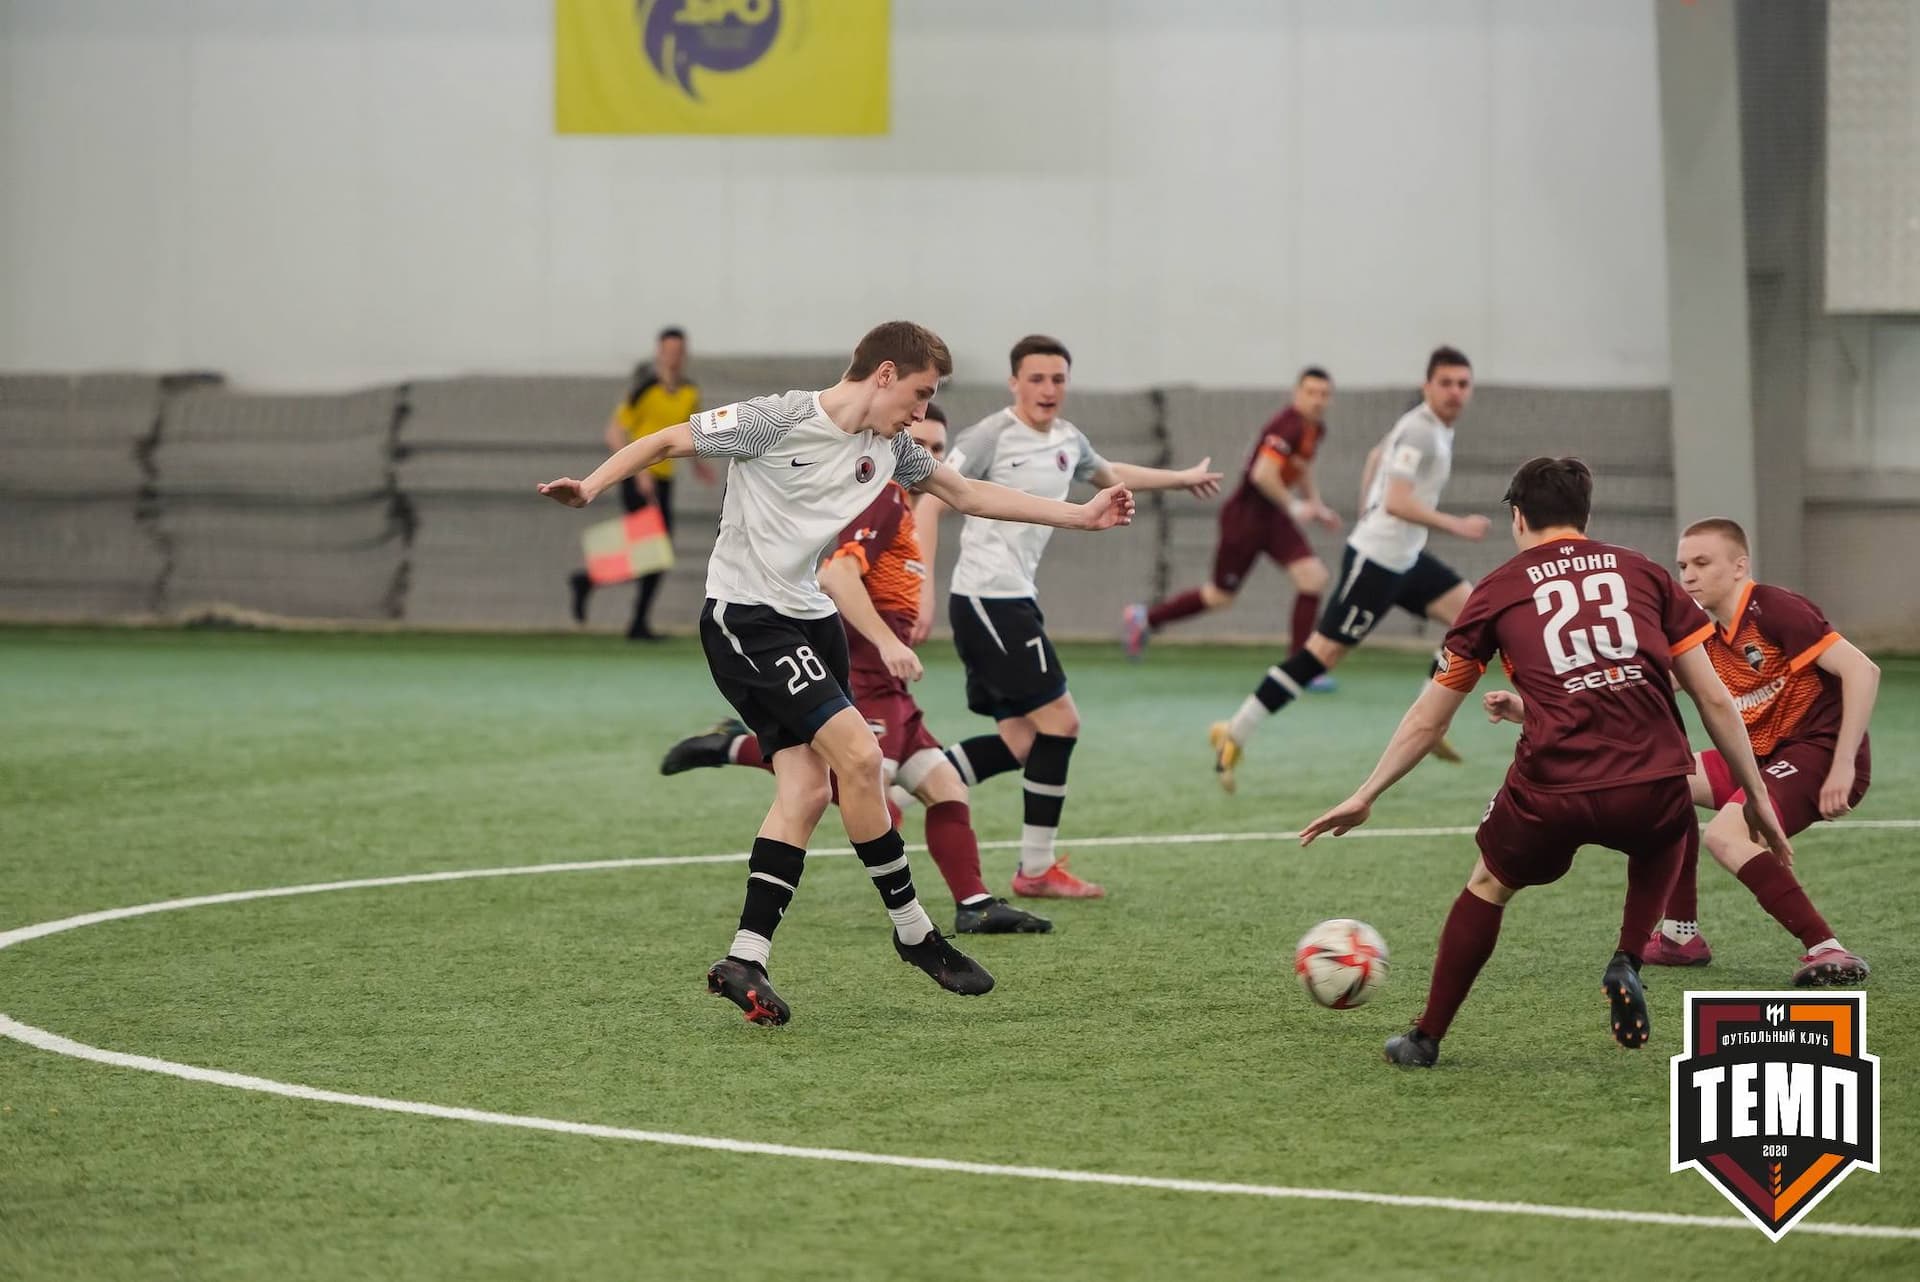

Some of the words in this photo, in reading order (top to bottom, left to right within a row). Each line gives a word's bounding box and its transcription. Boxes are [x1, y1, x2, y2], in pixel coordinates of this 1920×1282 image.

[1526, 553, 1618, 585] ВОРОНА
[1532, 572, 1639, 675] 23
[775, 645, 827, 695] 28
[1025, 636, 1048, 673] 7
[1562, 664, 1643, 694] SEUS
[1765, 760, 1799, 779] 27
